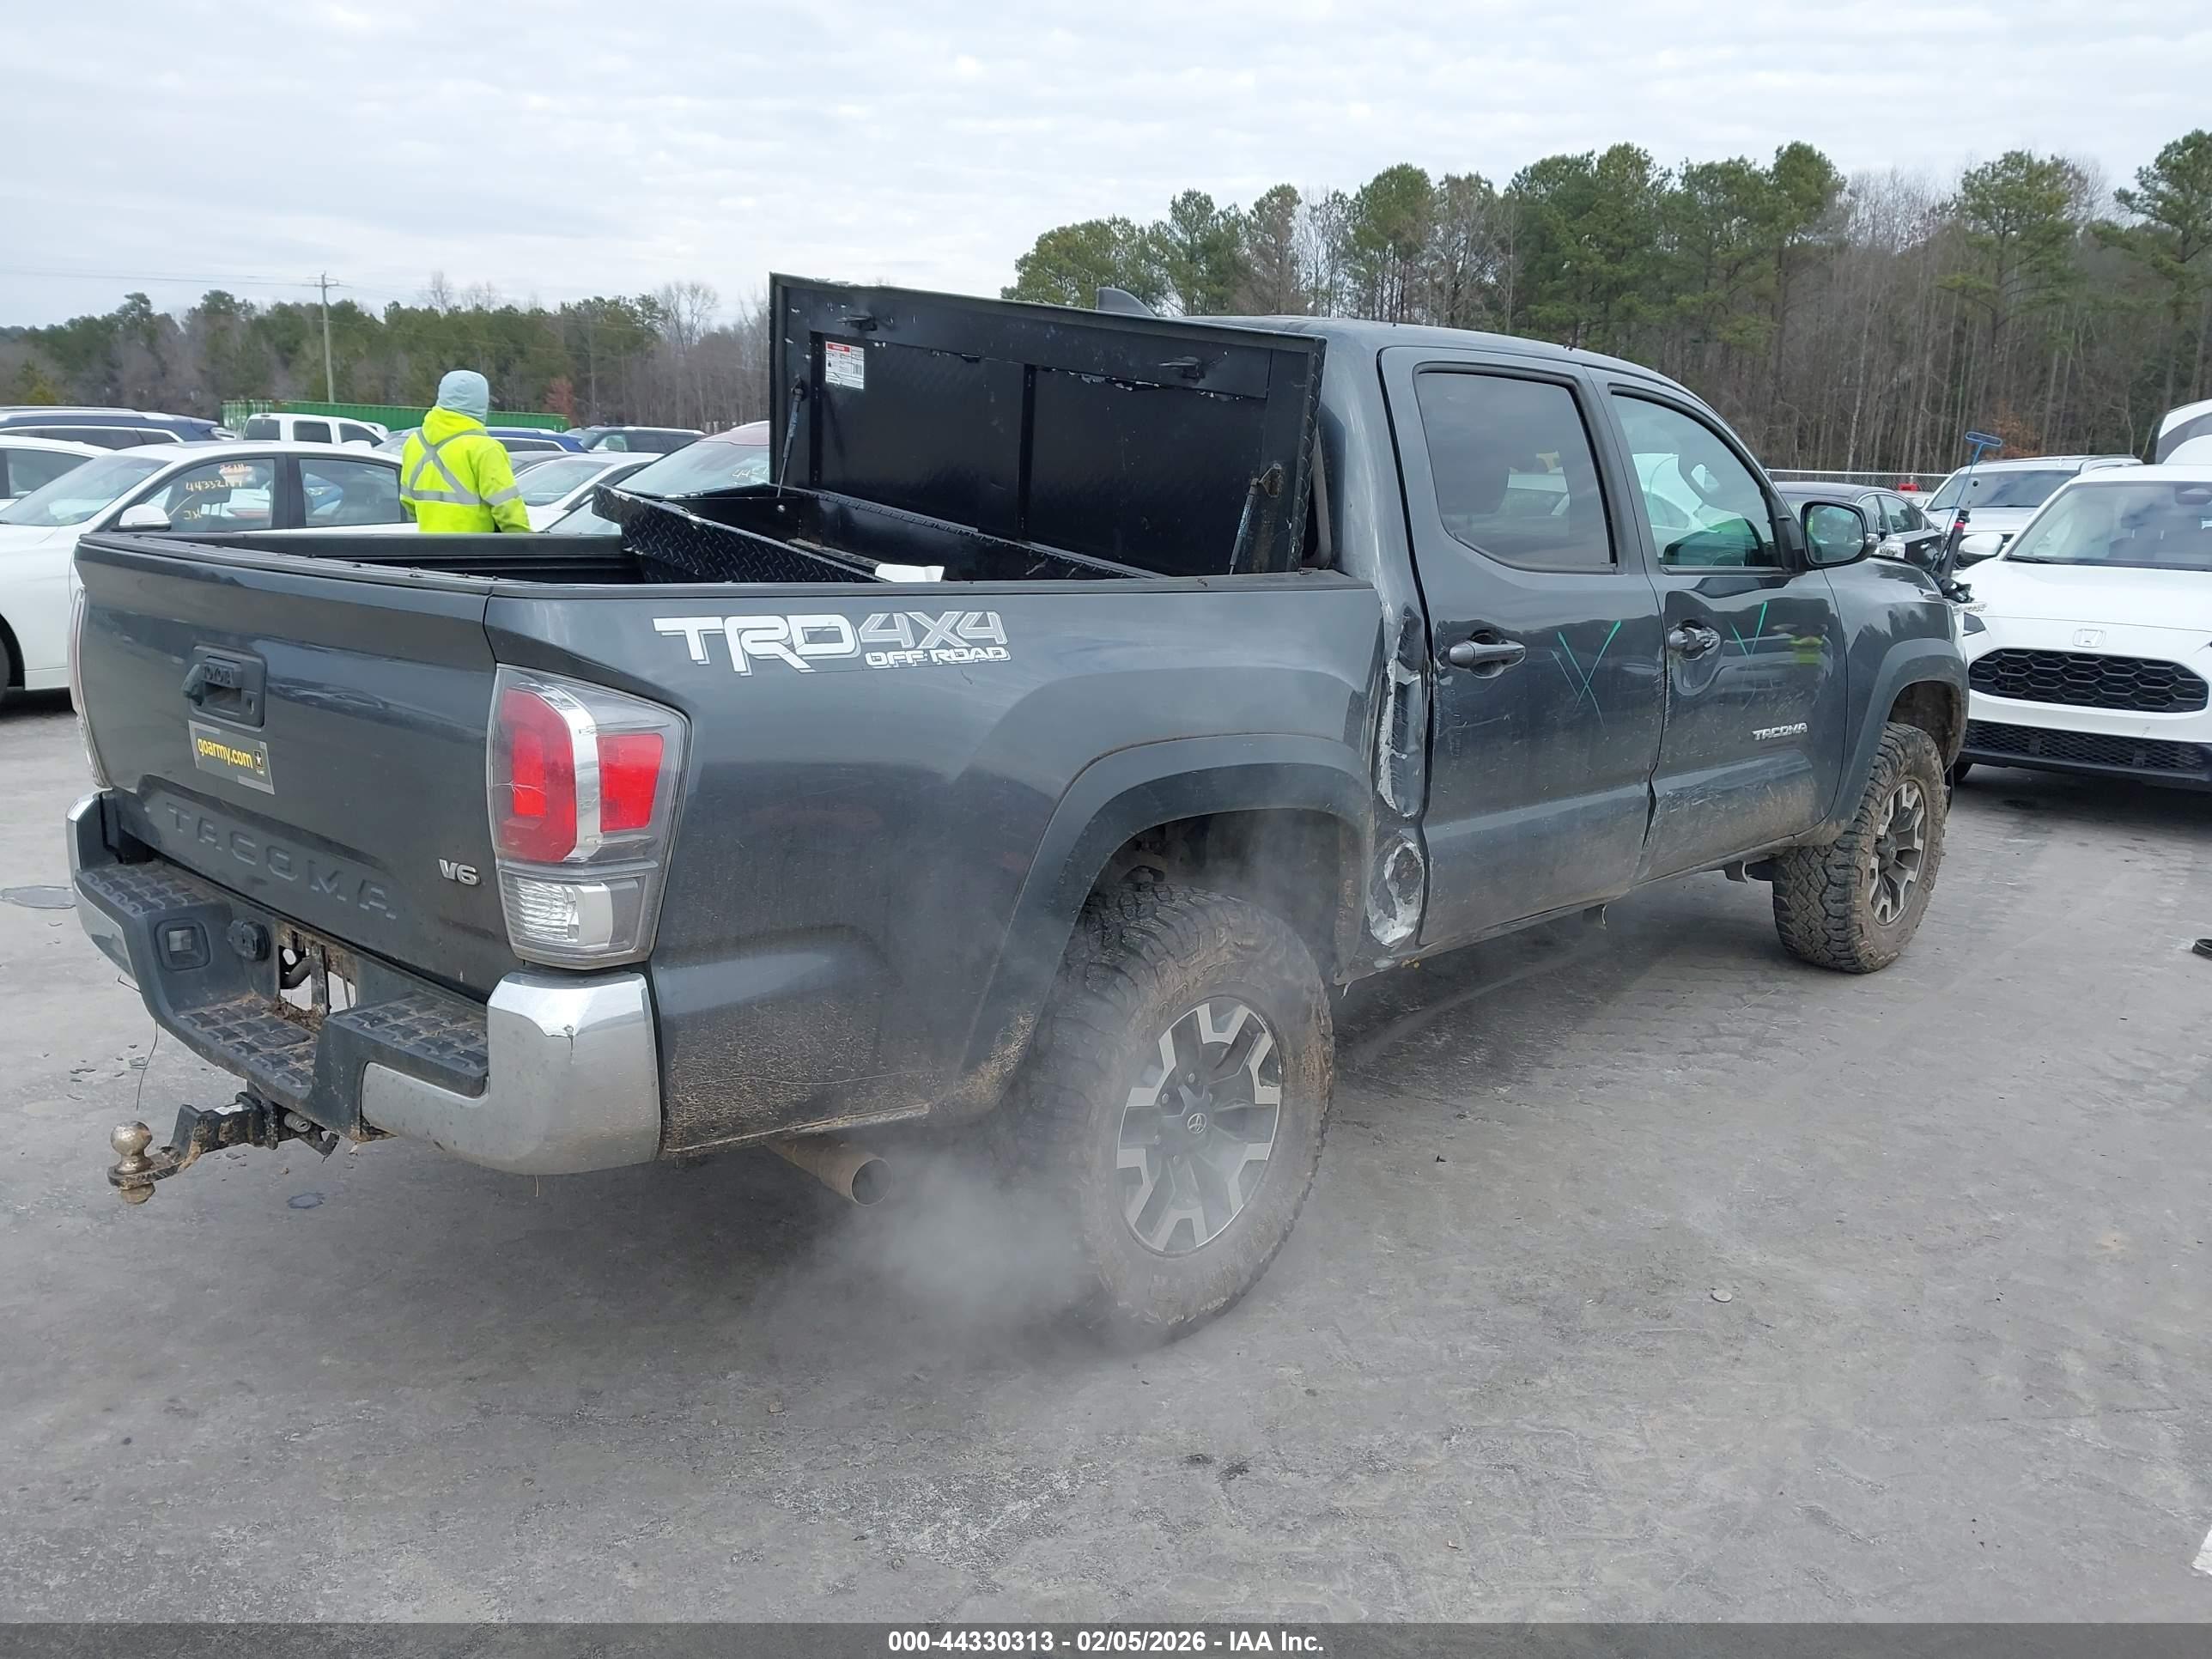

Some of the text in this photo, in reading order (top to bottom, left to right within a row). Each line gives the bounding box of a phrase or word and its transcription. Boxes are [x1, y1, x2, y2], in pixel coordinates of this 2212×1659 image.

[653, 611, 1010, 678] TRD 4X4
[865, 647, 1012, 669] OFF ROAD
[1751, 722, 1808, 741] TACOMA
[197, 738, 253, 769] goarmy.com
[166, 801, 398, 921] TACOMA
[439, 858, 482, 886] V6
